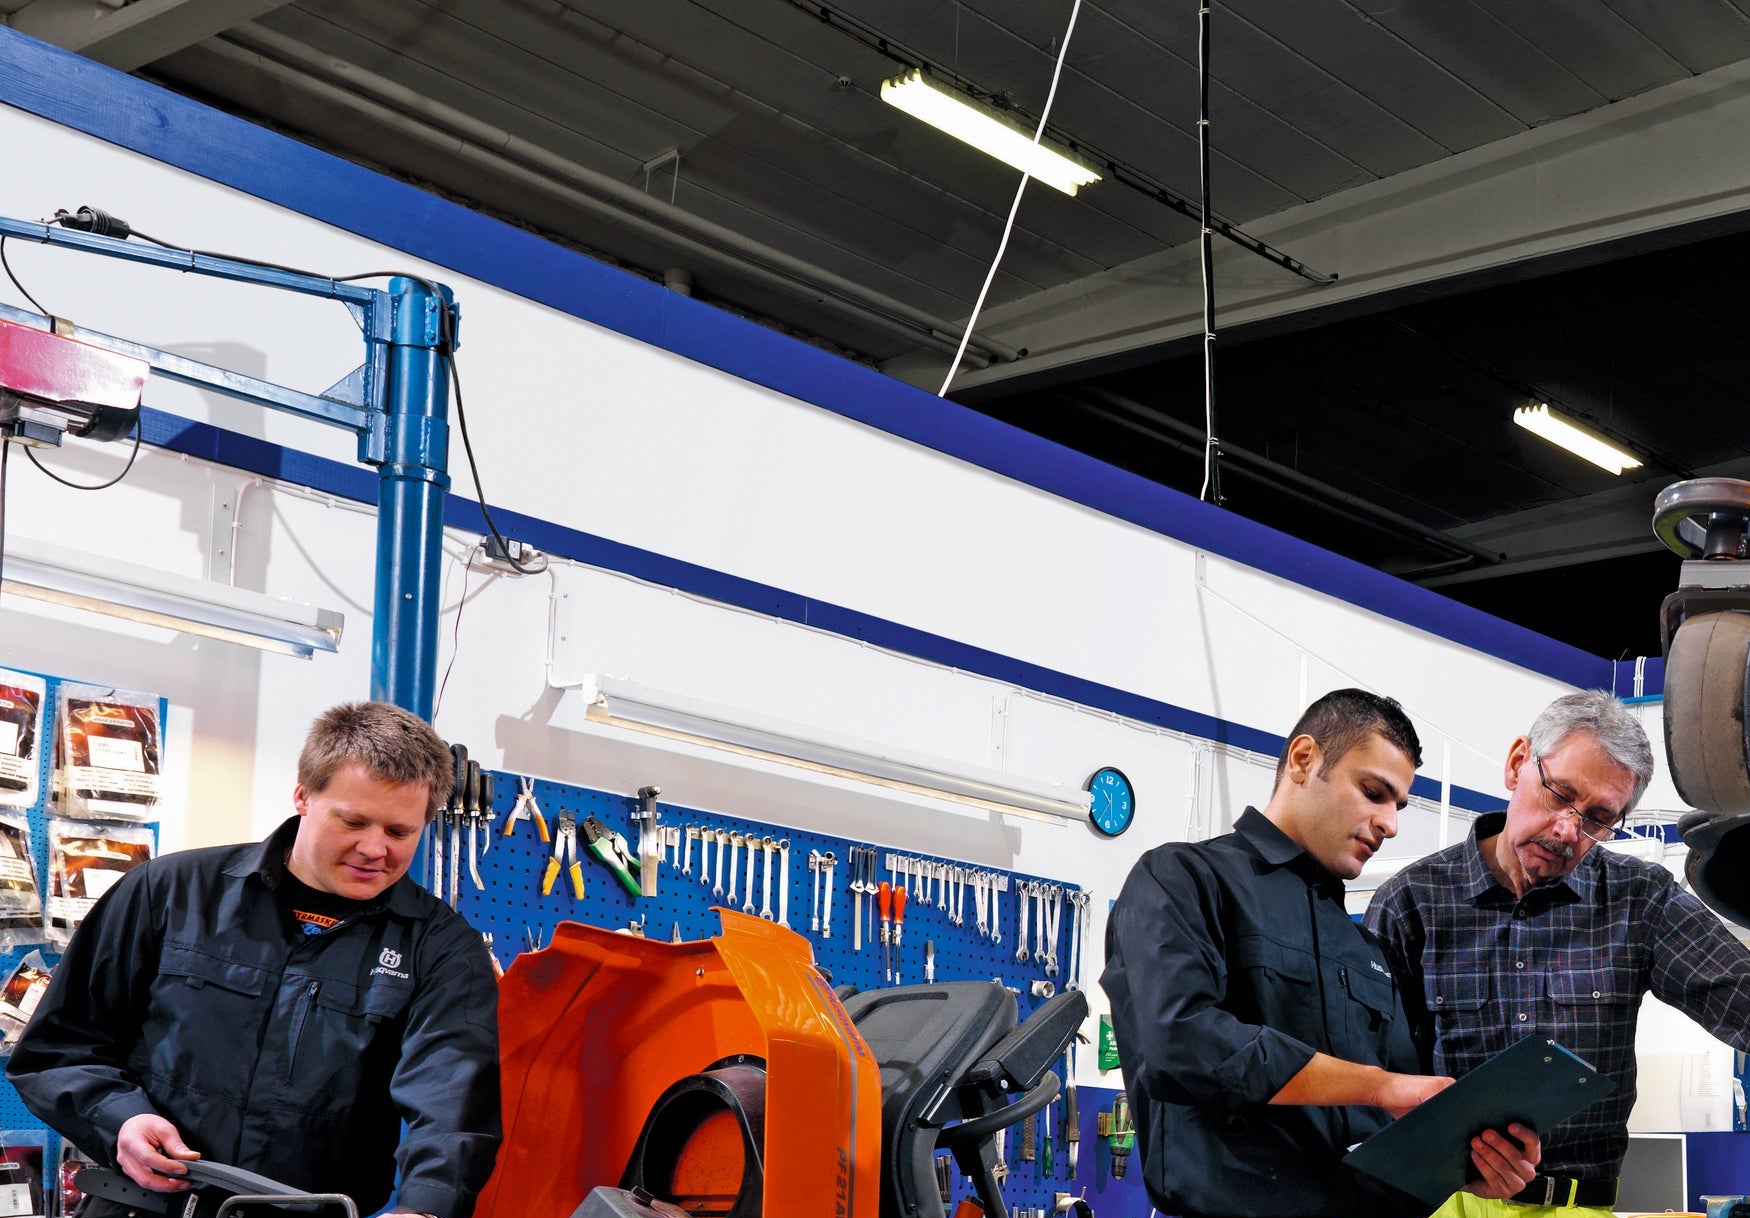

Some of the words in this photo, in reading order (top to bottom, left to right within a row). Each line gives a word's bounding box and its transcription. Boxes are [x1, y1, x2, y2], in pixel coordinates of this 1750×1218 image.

[1106, 775, 1114, 785] 12
[1121, 801, 1127, 810] 3
[1105, 820, 1111, 829] 6
